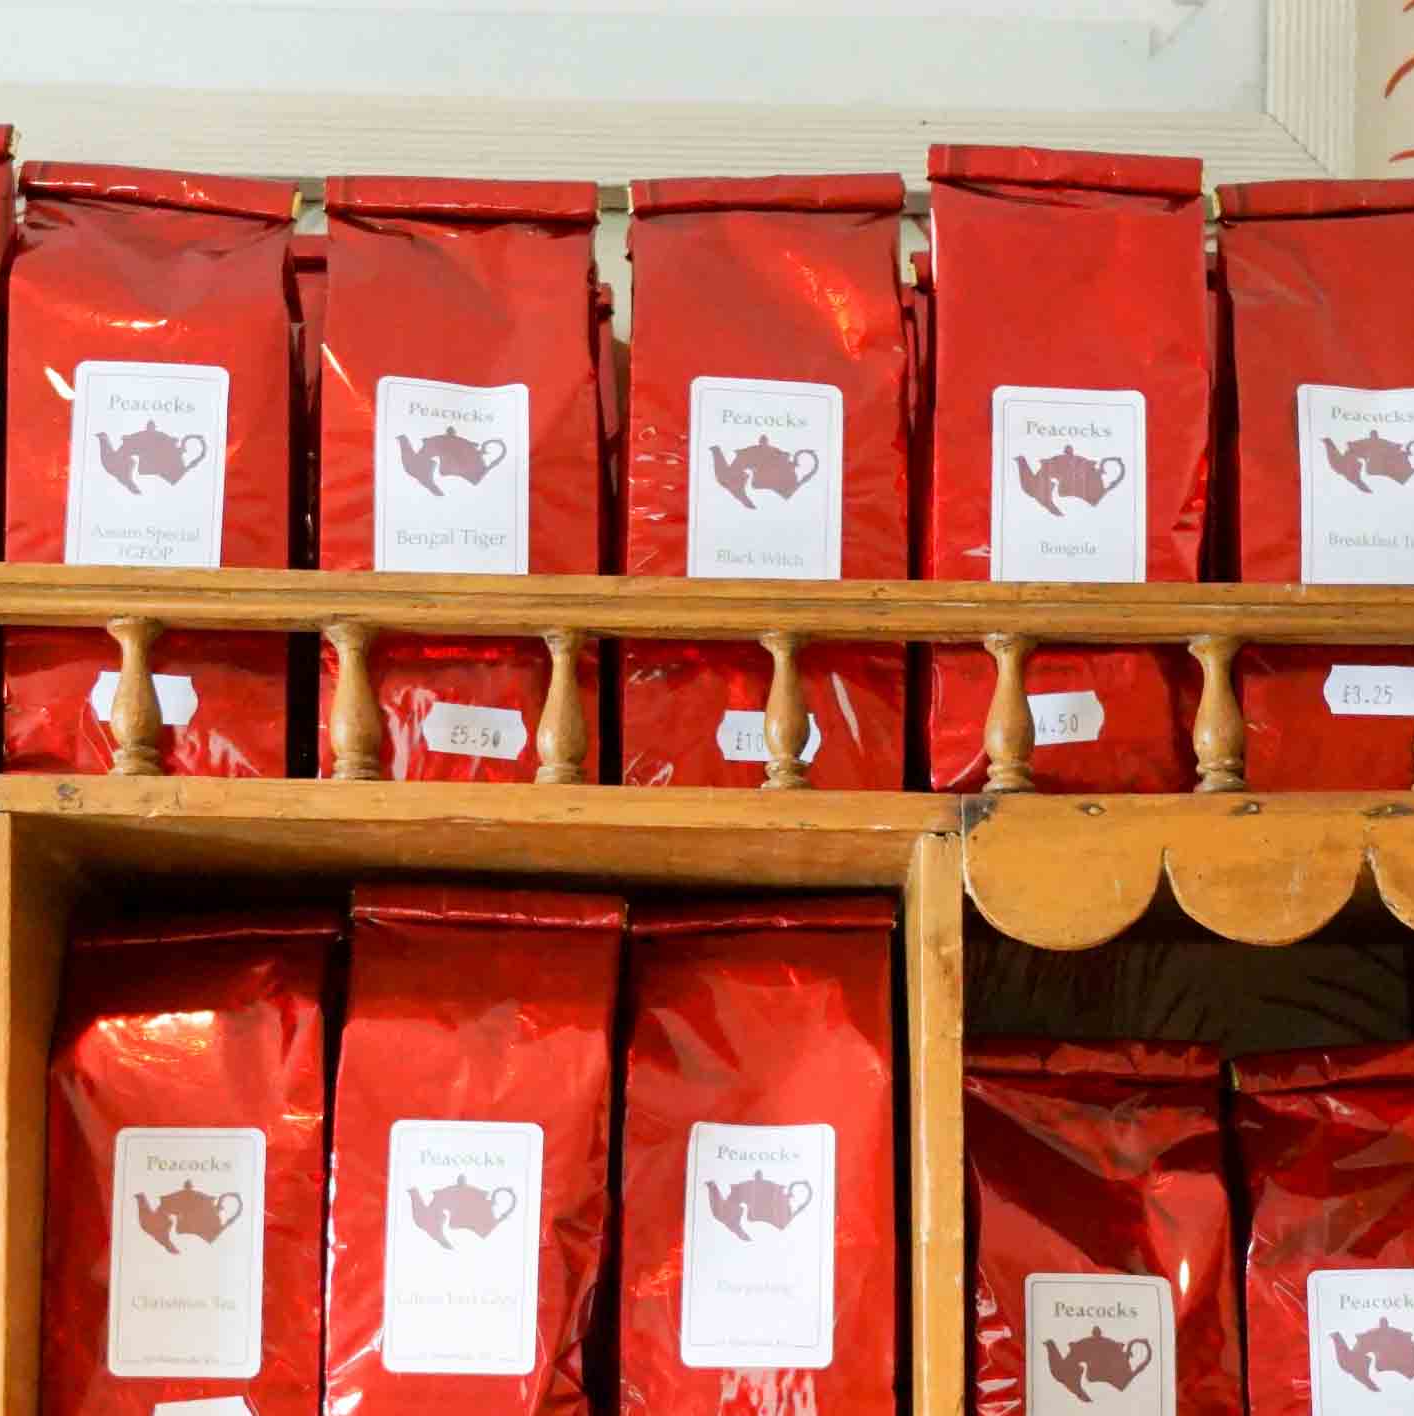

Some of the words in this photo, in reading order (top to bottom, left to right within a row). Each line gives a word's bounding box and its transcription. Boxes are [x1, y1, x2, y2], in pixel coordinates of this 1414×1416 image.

[108, 393, 196, 413] Peacocks
[408, 401, 498, 424] Peacocks
[722, 409, 810, 428] Peacocks
[1026, 420, 1113, 438] Peacocks
[146, 525, 201, 544] Special
[396, 530, 453, 550] Bengal
[459, 529, 507, 550] Tiger
[1341, 684, 1391, 704] £3.25
[1036, 713, 1077, 736] 4.50
[449, 725, 499, 748] £5.50
[419, 1149, 506, 1167] Peacocks
[715, 1144, 801, 1161] Peacocks
[146, 1156, 233, 1172] Peacocks
[1053, 1301, 1139, 1319] Peacocks
